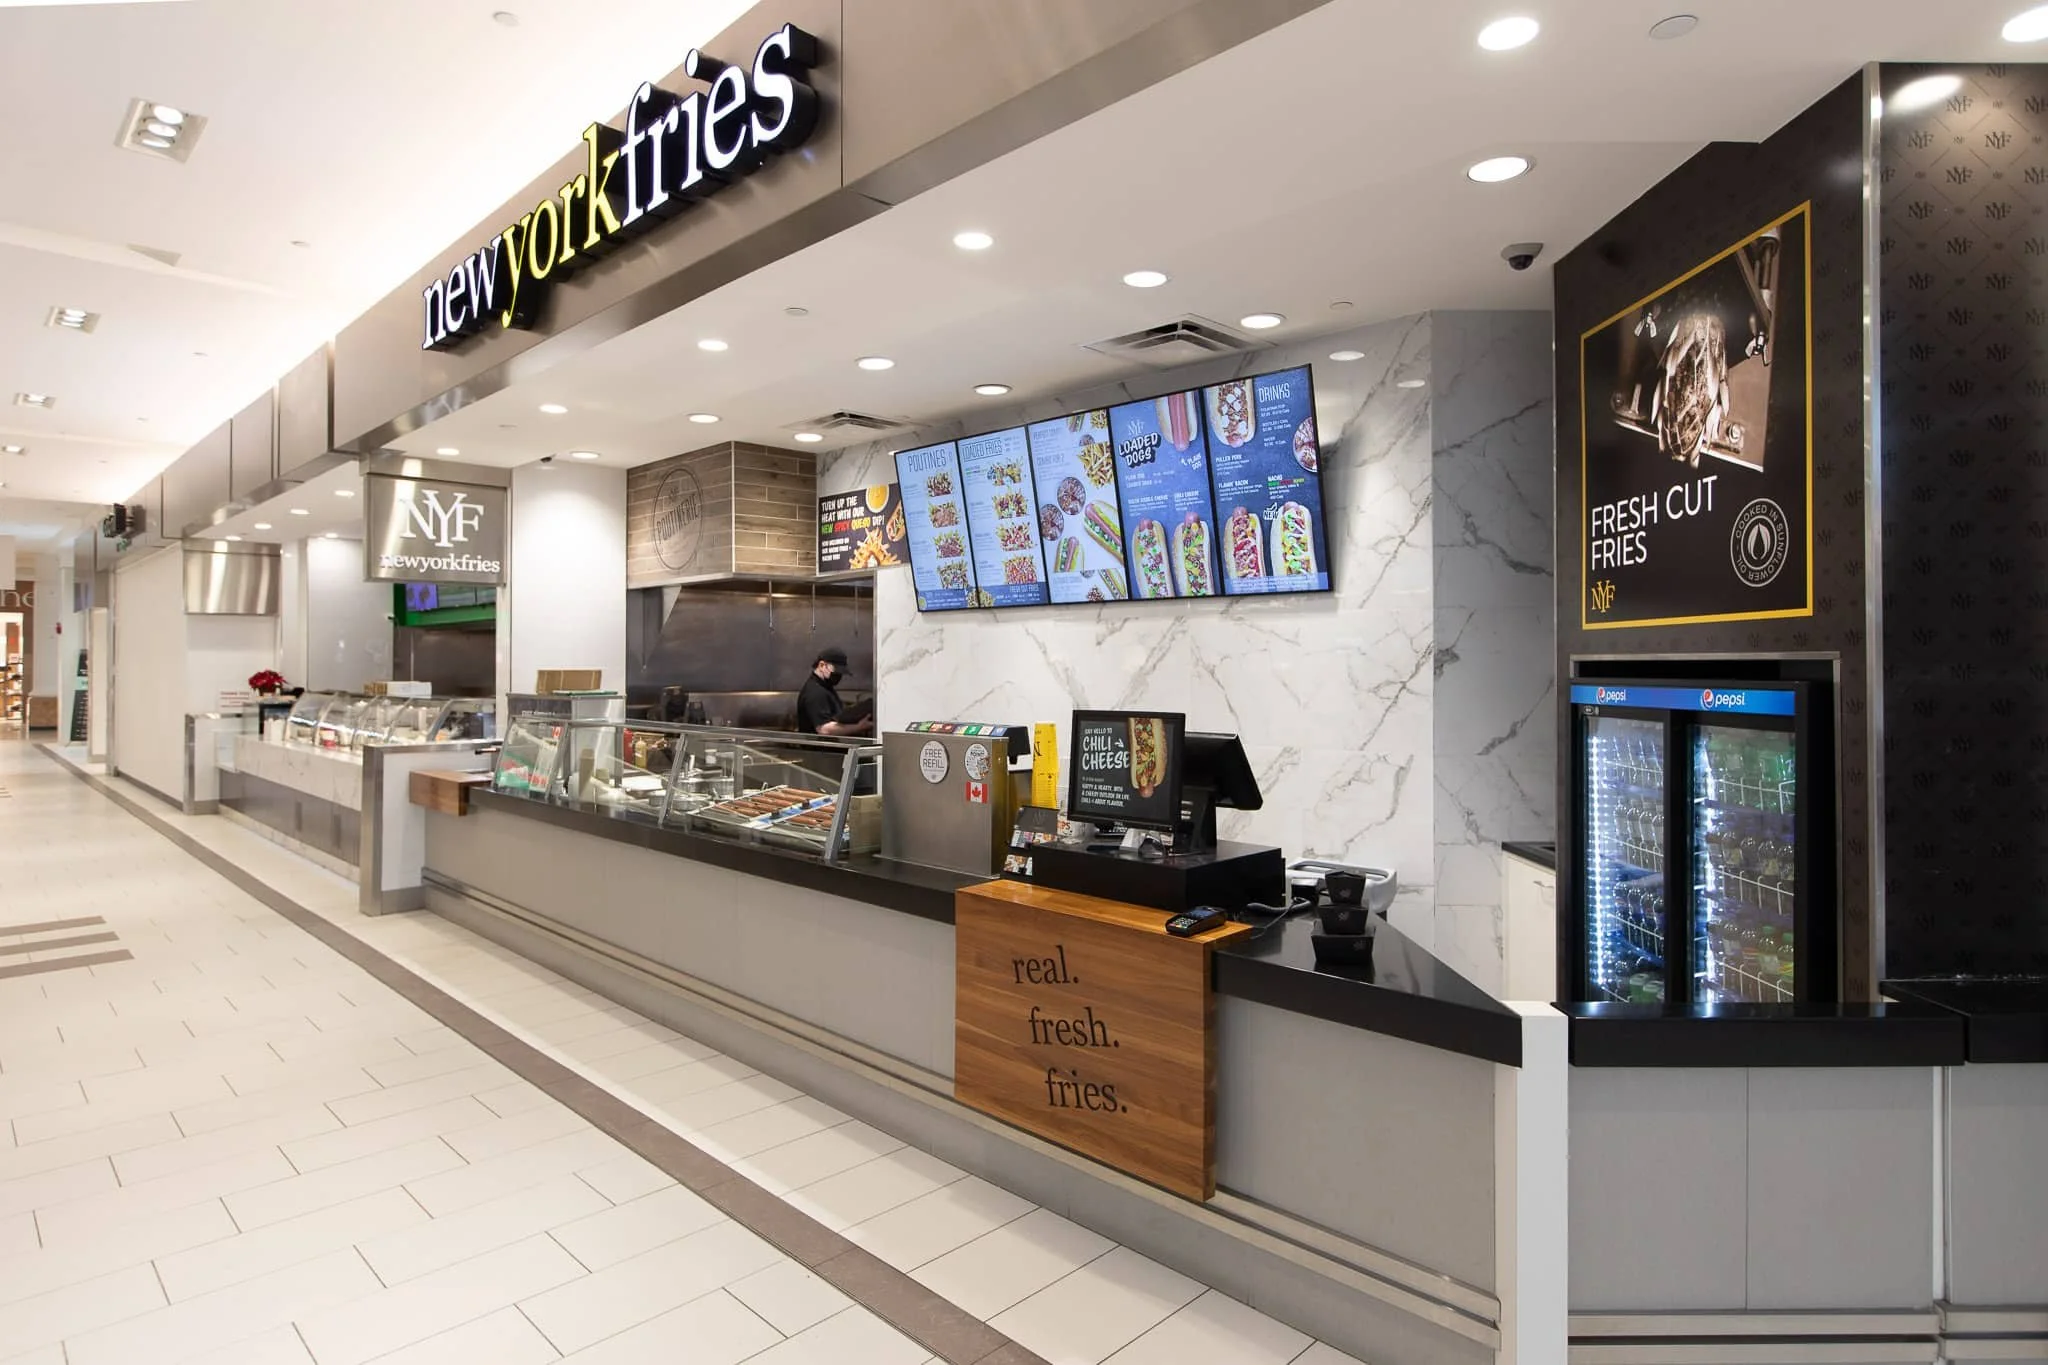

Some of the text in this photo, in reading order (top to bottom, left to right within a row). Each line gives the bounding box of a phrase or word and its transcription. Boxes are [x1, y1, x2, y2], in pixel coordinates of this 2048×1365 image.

[1259, 383, 1290, 402] DRINKS
[1119, 433, 1158, 455] LOADED
[908, 449, 946, 472] POUTINES
[1126, 447, 1151, 466] DOGS
[1592, 475, 1718, 538] FRESH CUT
[399, 489, 484, 548] NYF
[1592, 531, 1647, 571] FRIES
[1736, 505, 1785, 580] COOKED IN SUNFLOWER OIL
[380, 554, 500, 573] newyorkfries
[1591, 580, 1615, 613] NYF
[1606, 689, 1626, 702] pepsi
[1714, 692, 1745, 708] pepsi
[924, 749, 942, 758] FREE
[1083, 736, 1111, 751] CHILI
[923, 759, 944, 768] REFILL
[1082, 751, 1130, 770] CHEESE
[1012, 945, 1079, 984] real.
[1028, 1006, 1120, 1048] fresh.
[1044, 1068, 1127, 1113] fries.
